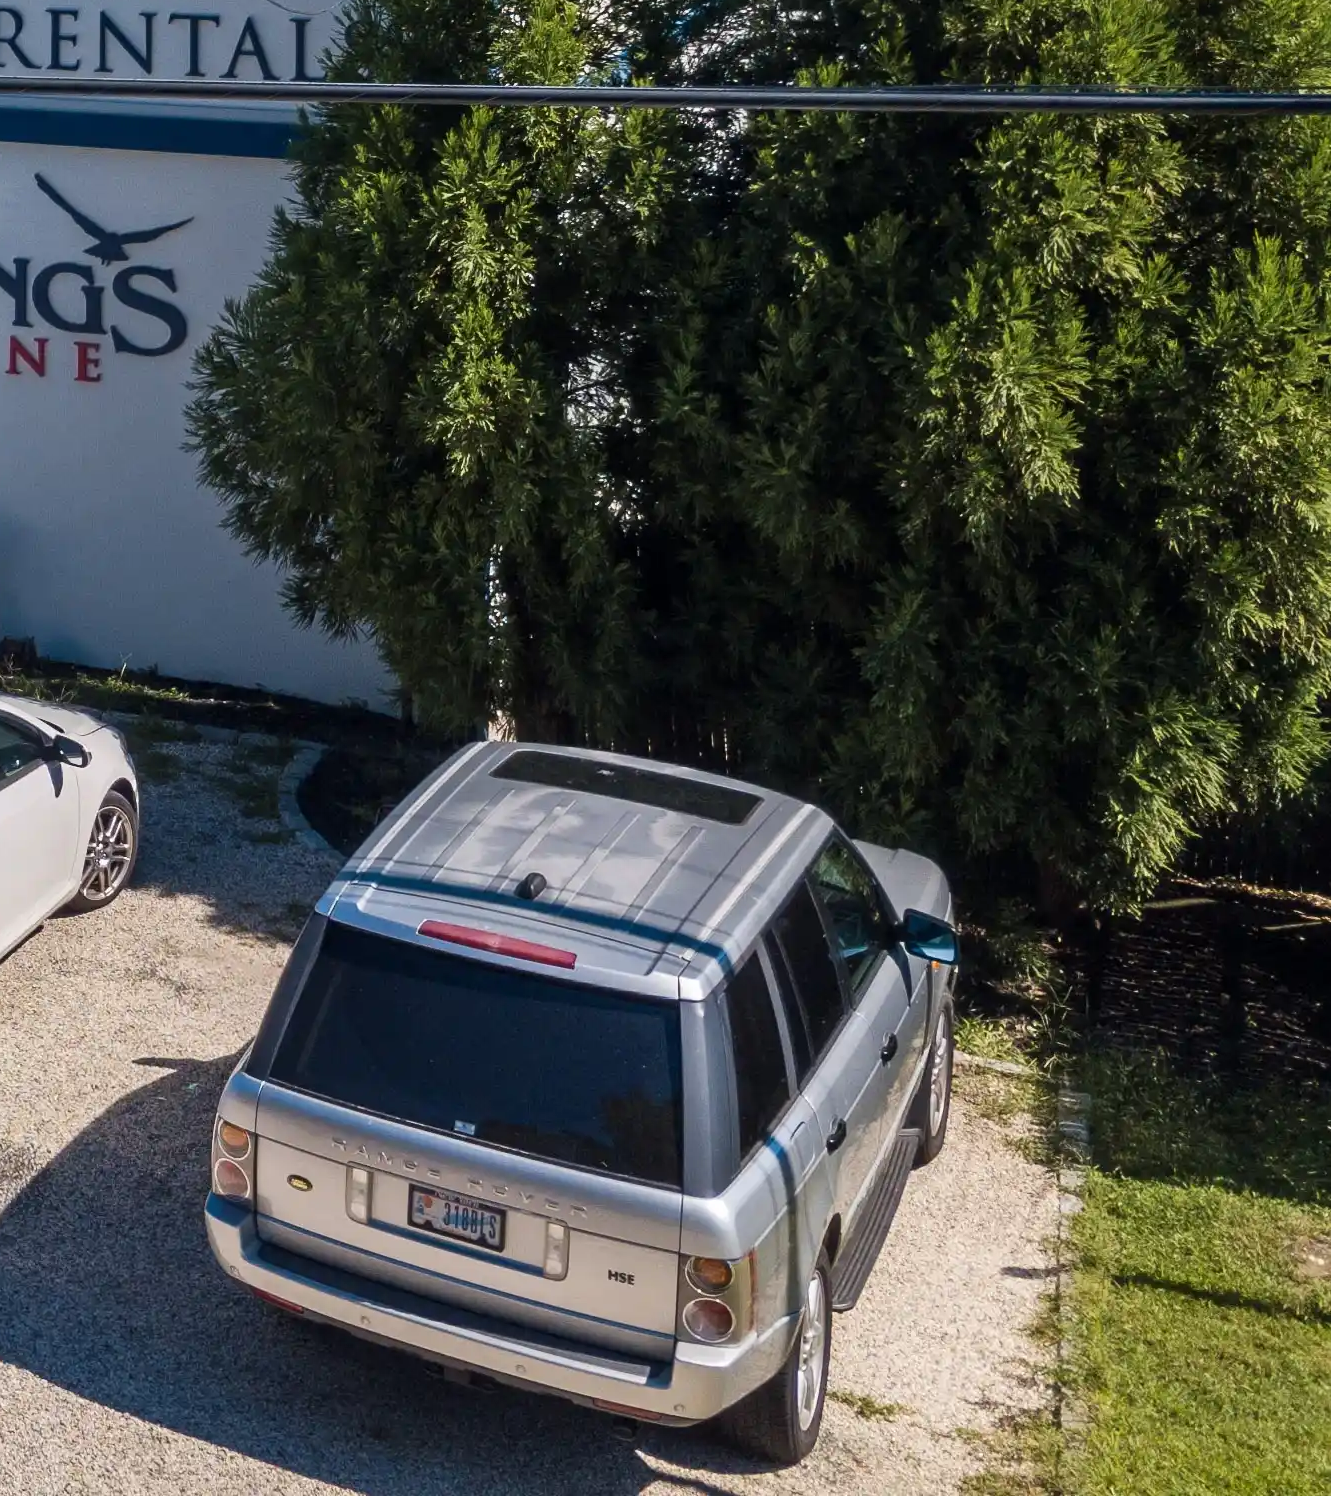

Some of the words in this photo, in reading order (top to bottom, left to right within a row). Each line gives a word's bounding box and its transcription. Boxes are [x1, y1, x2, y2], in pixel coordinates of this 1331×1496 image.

[332, 1136, 441, 1179] RANGE
[467, 1177, 588, 1218] ROVER
[607, 1269, 636, 1286] HSE
